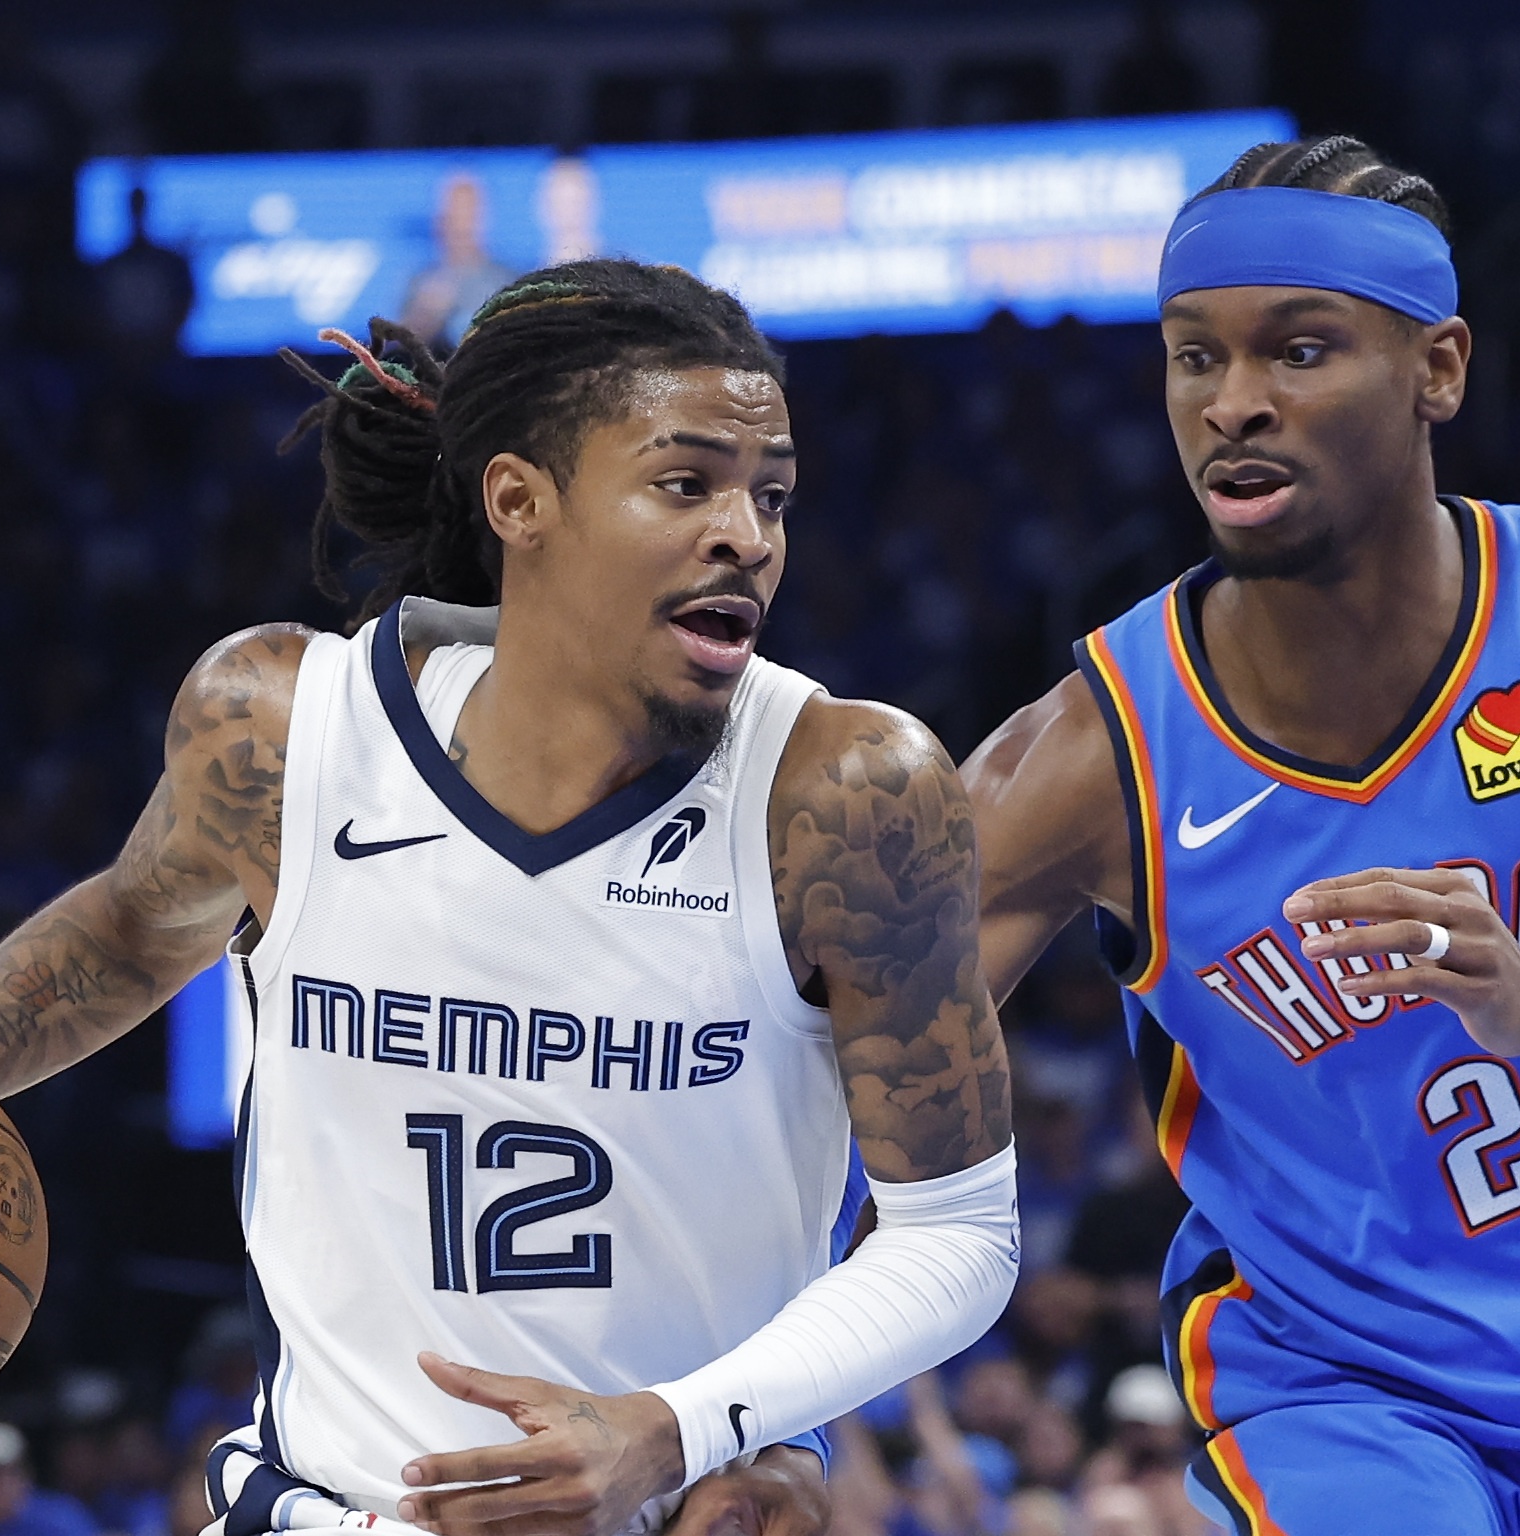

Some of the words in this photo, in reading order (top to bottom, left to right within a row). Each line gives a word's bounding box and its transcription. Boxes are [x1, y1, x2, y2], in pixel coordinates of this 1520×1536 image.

[606, 881, 729, 912] Robinhood
[292, 974, 750, 1091] MEMPHIS
[406, 1113, 612, 1294] 12
